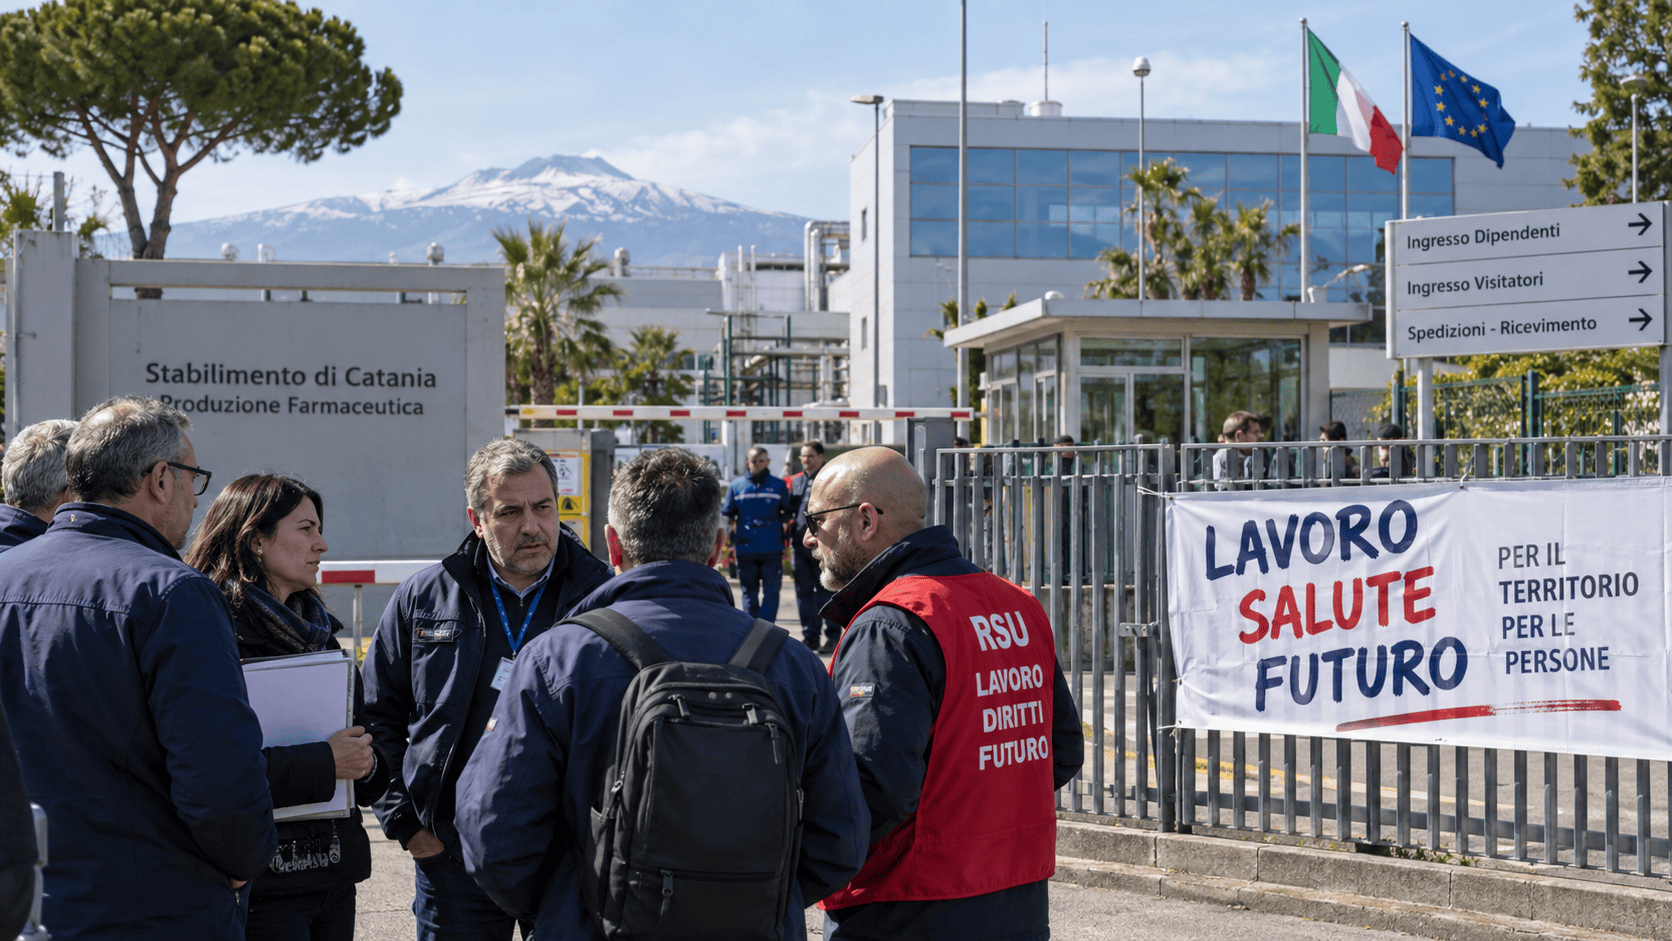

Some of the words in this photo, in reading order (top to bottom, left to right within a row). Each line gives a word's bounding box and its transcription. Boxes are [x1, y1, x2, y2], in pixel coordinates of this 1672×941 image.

[1407, 233, 1470, 252] Ingresso
[1474, 222, 1560, 246] Dipendenti
[1407, 280, 1470, 298] Ingresso
[1474, 272, 1543, 290] Visitatori
[1408, 322, 1485, 343] Spedizioni
[1500, 316, 1597, 335] Ricevimento
[146, 362, 307, 387] Stabilimento
[314, 365, 338, 388] di
[345, 366, 437, 388] Catania
[160, 395, 281, 414] Produzione
[288, 396, 424, 416] Farmaceutica
[1206, 499, 1419, 582] LAVORO
[1498, 544, 1540, 570] PER
[1546, 542, 1567, 567] IL
[1499, 571, 1640, 605] TERRITORIO
[1239, 566, 1436, 645] SALUTE
[969, 610, 1030, 652] RSU
[1501, 614, 1545, 640] PER
[1551, 612, 1576, 638] LE
[1255, 636, 1469, 713] FUTURO
[1505, 645, 1611, 675] PERSONE
[975, 663, 1044, 698] LAVORO
[982, 700, 1044, 733] DIRITTI
[979, 735, 1049, 770] FUTURO
